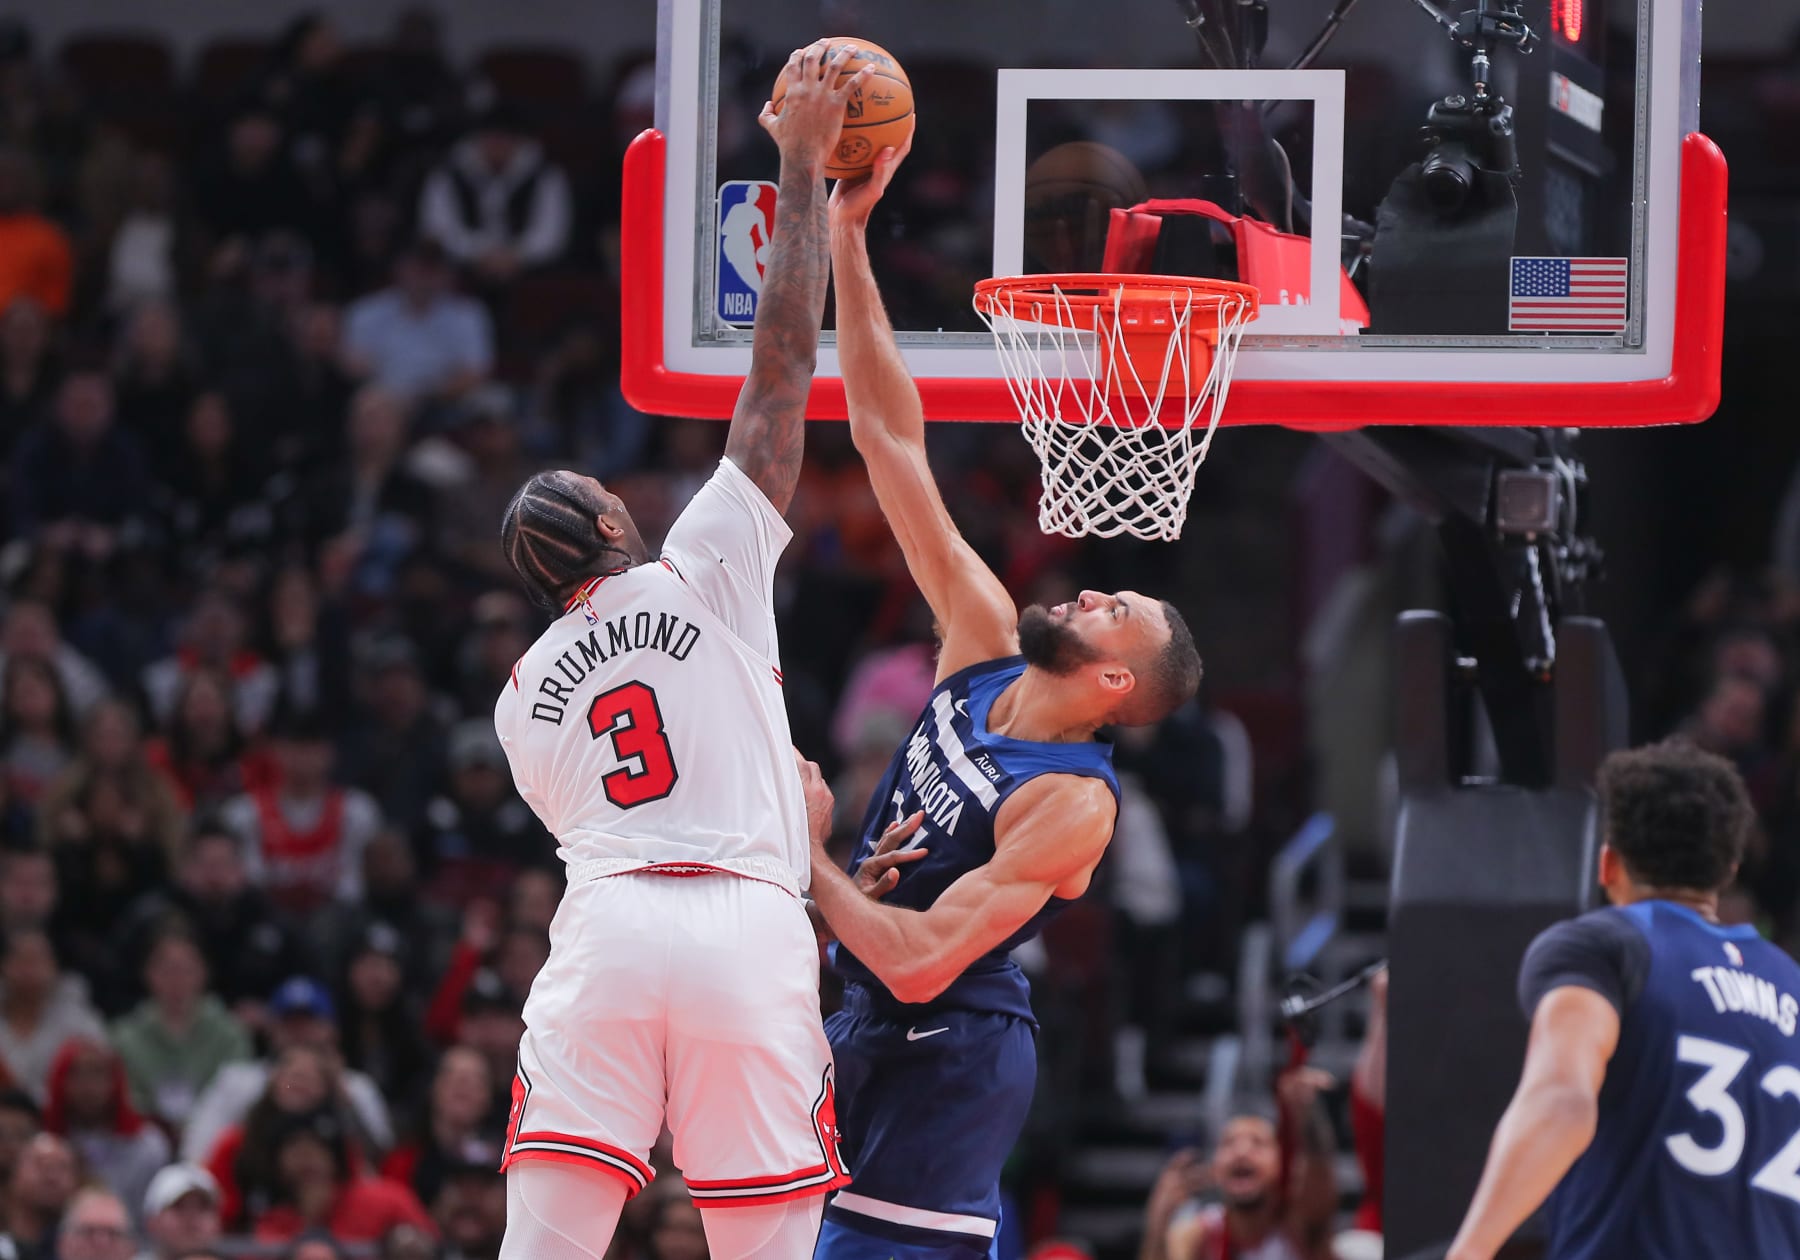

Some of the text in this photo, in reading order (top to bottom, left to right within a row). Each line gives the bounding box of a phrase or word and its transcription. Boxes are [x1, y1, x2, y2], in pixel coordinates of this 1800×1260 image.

[724, 293, 753, 315] NBA
[531, 611, 701, 726] DRUMMOND
[586, 679, 679, 811] 3
[1690, 965, 1799, 1038] TOWNS
[1664, 1035, 1800, 1205] 32
